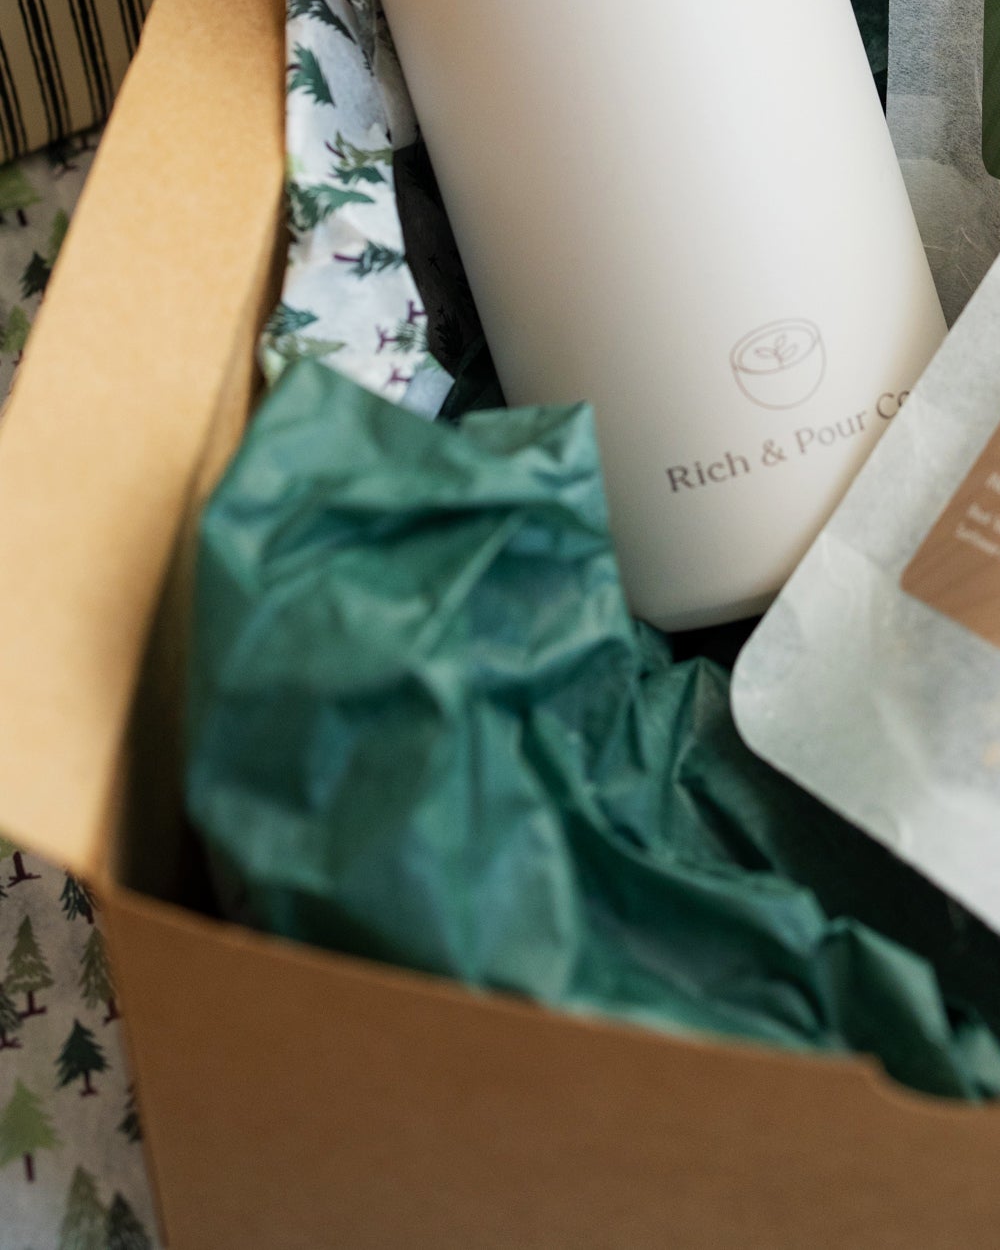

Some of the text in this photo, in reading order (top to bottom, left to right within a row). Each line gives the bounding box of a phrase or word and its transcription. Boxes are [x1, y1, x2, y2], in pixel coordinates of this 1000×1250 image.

[666, 451, 750, 493] Rich
[760, 438, 788, 467] &
[794, 409, 868, 456] Pour
